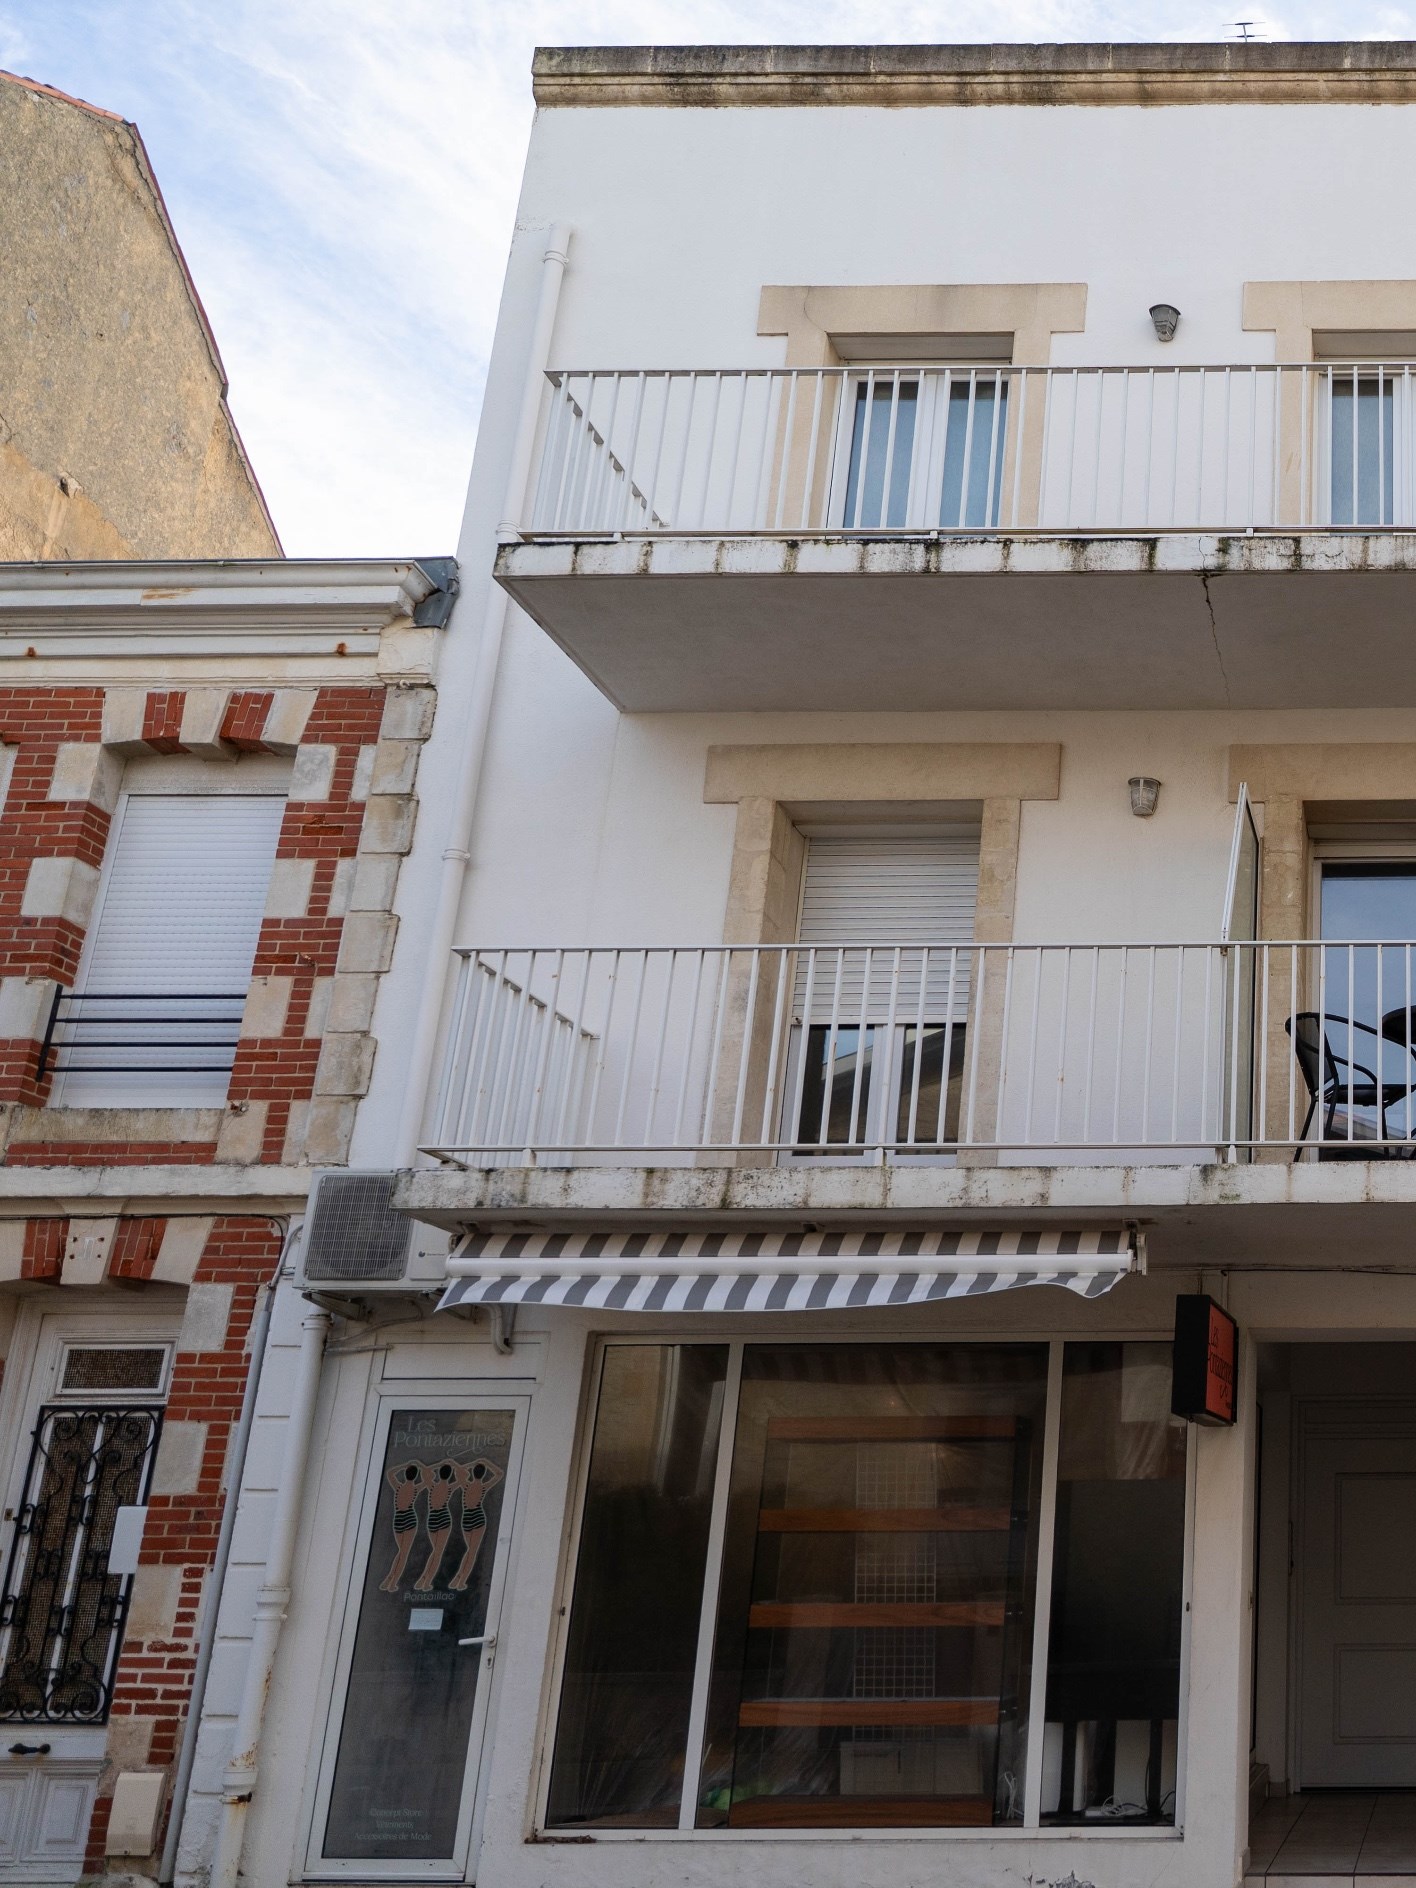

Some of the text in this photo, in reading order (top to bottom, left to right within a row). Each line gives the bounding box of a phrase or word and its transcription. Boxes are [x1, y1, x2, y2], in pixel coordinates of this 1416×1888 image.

[407, 1415, 436, 1432] Les
[394, 1430, 506, 1457] Pontaziennes
[404, 1591, 455, 1602] Pontaillac
[410, 1832, 433, 1841] Mode
